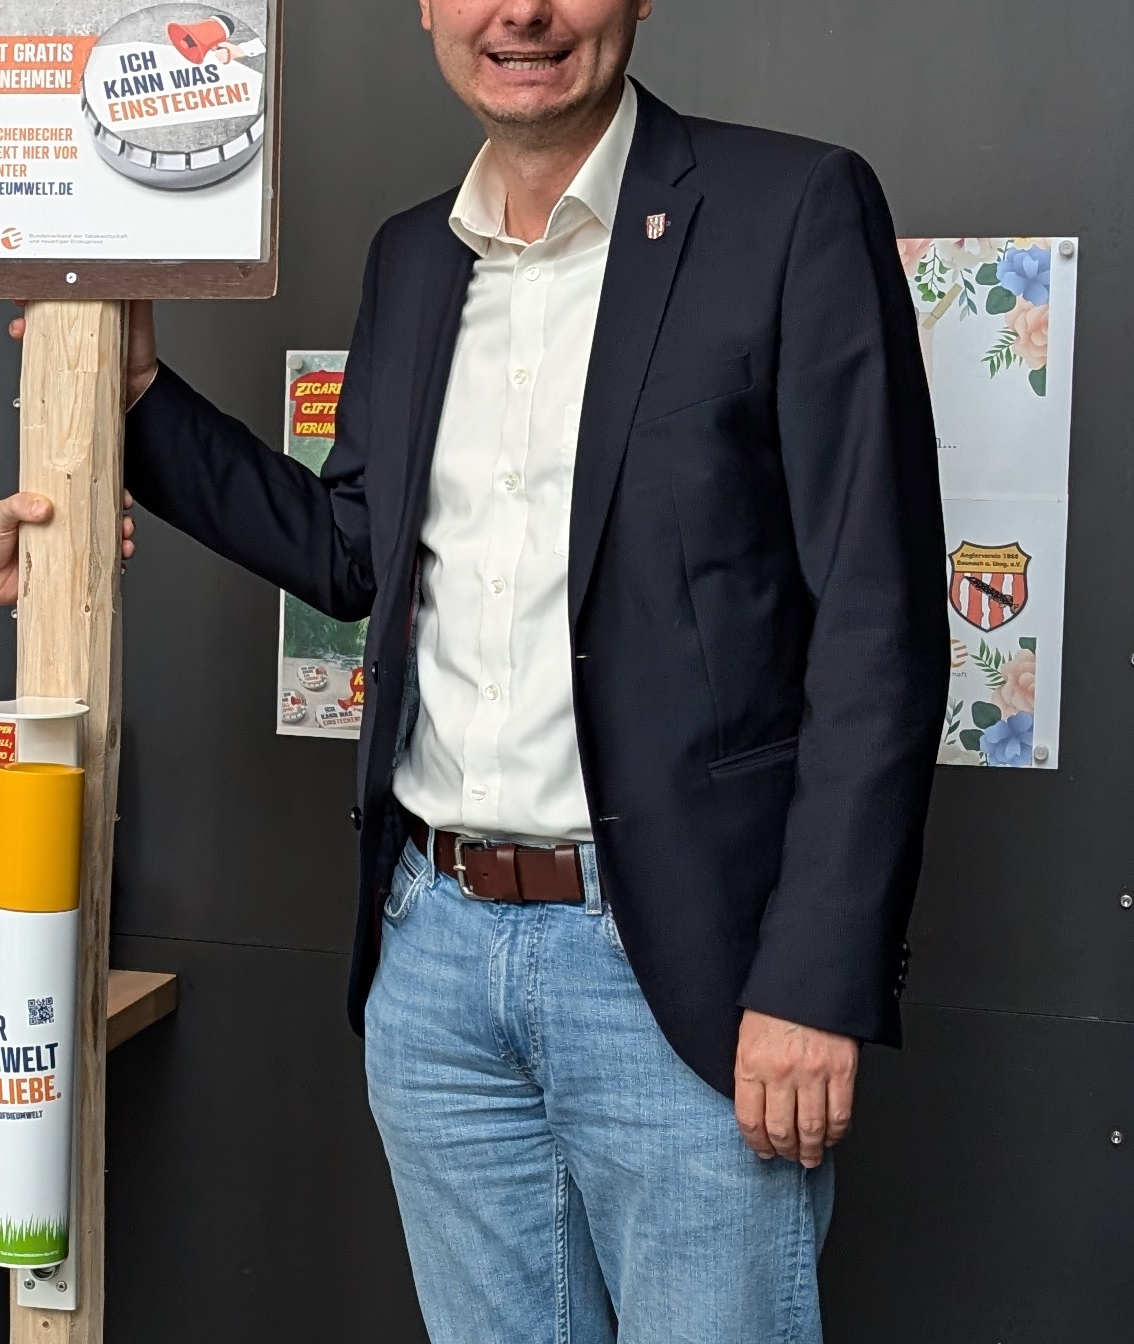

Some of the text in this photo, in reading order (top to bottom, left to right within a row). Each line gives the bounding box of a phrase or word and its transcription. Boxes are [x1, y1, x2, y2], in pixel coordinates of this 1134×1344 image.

[13, 42, 73, 62] GRATIS
[119, 50, 157, 74] ICH
[102, 63, 221, 99] KANN WAS
[107, 81, 250, 122] EINSTECKEN!
[22, 145, 49, 159] HIER
[53, 145, 78, 159] VOR
